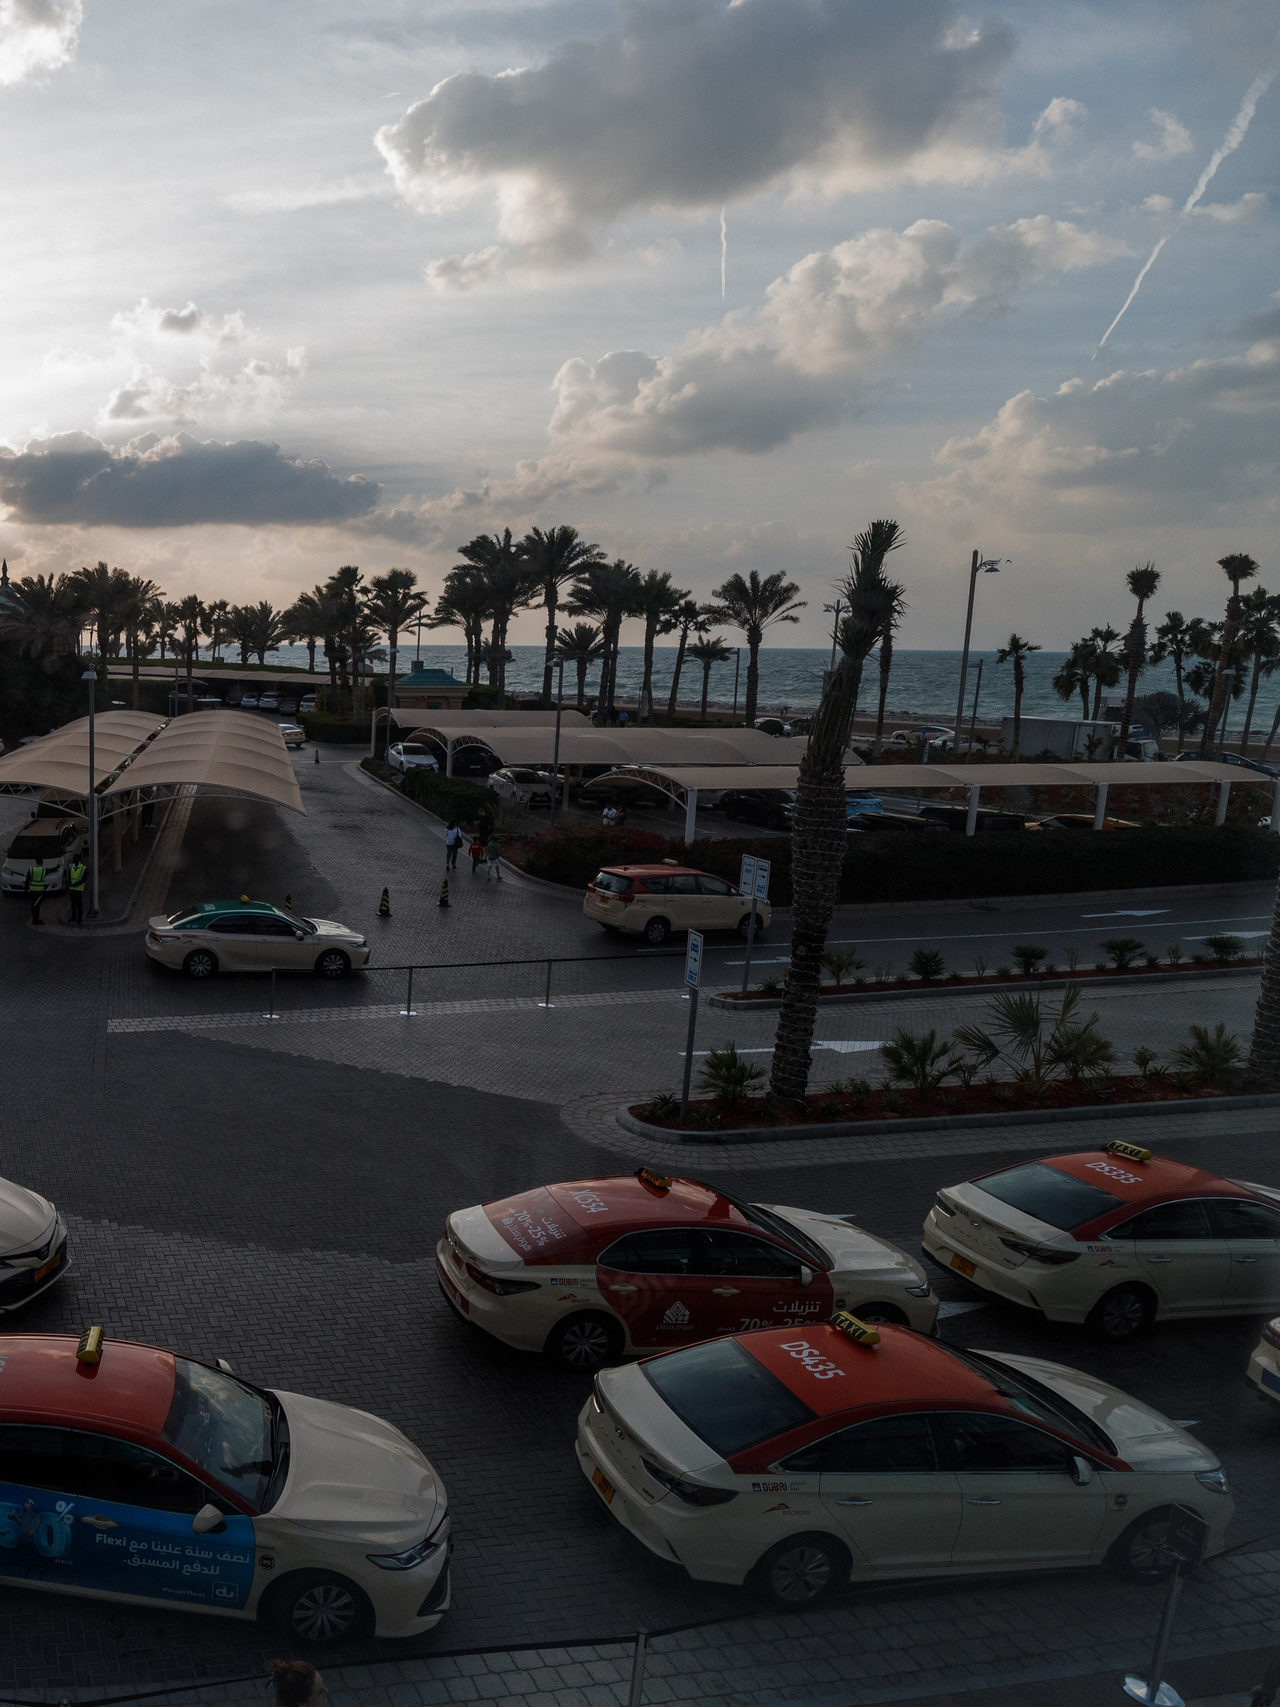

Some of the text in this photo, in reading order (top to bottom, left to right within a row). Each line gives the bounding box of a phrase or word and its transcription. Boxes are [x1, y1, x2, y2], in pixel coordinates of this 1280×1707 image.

[1112, 1142, 1138, 1156] TAXI
[1084, 1162, 1144, 1184] DS335
[772, 1300, 820, 1315] تنزيلات
[835, 1315, 864, 1337] TAXI
[780, 1340, 846, 1380] DS435
[762, 1482, 788, 1492] DUBAI
[96, 1533, 127, 1546] Flexi
[129, 1540, 148, 1552] مع
[152, 1540, 182, 1554] علينا
[185, 1545, 213, 1558] سنة
[216, 1550, 250, 1564] نصف
[182, 1561, 220, 1576] للدفع
